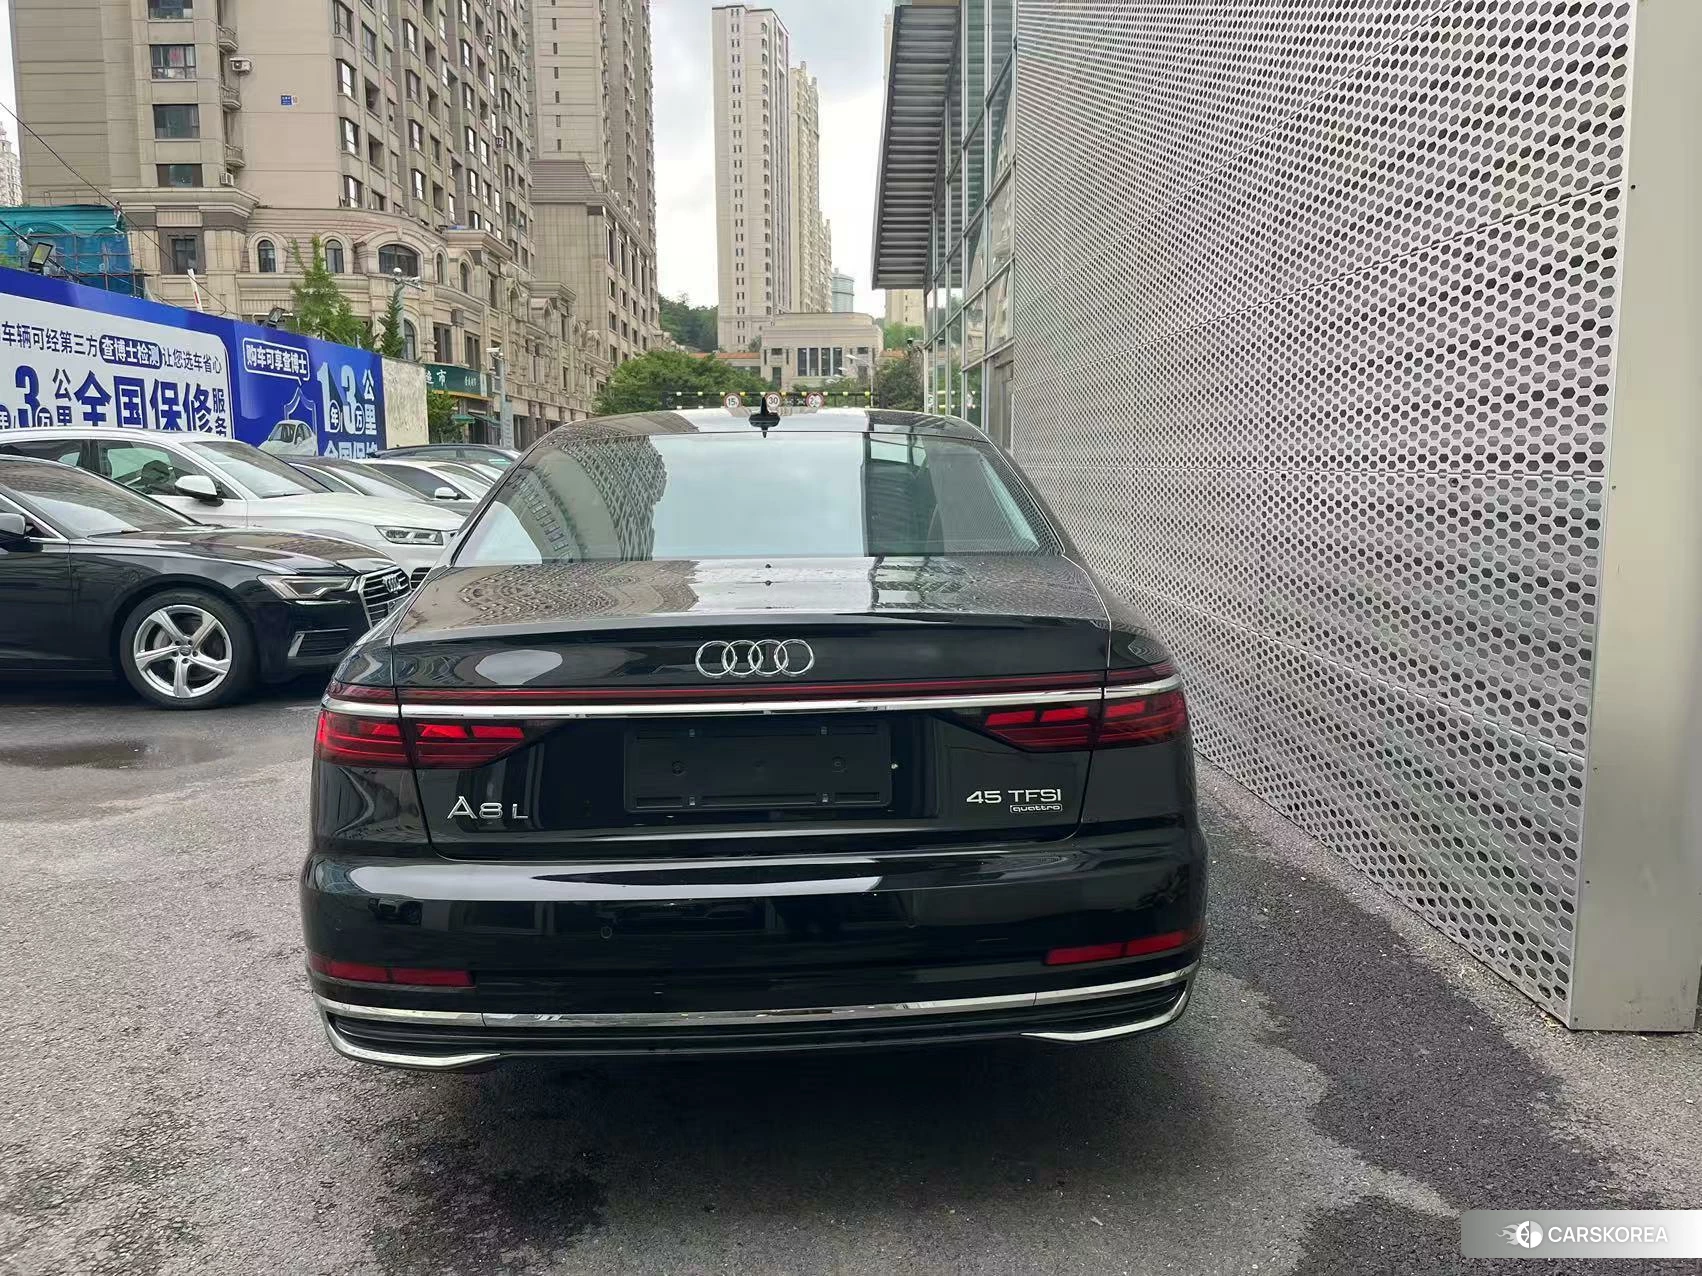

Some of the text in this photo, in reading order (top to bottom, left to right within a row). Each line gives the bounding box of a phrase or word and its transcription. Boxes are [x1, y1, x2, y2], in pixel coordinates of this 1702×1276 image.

[768, 396, 778, 405] 30
[966, 788, 1062, 803] 45 TFSI
[446, 795, 529, 819] A8 L
[1011, 804, 1061, 812] quattro
